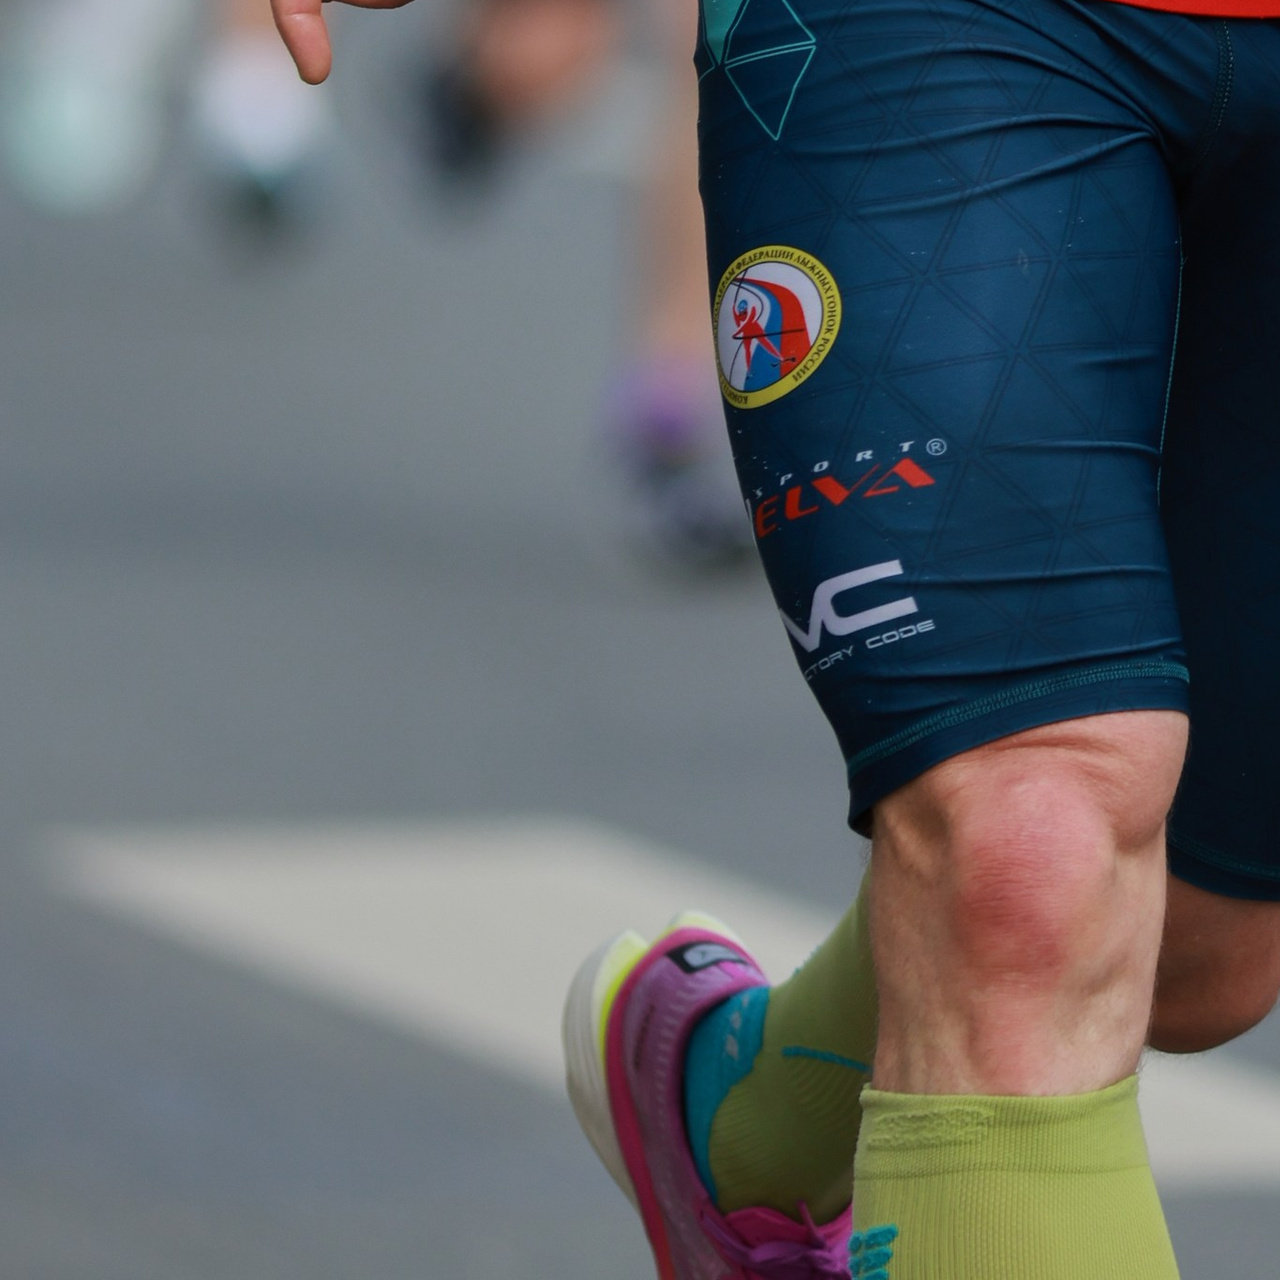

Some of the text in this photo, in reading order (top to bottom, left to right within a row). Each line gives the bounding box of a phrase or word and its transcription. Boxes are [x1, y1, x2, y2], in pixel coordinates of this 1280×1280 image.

[735, 249, 795, 271] ФЕДЕРАЦИИ
[794, 253, 833, 295] ЛЫЖНЫХ
[823, 292, 837, 335] ГОНОК
[792, 338, 830, 382] РОССИИ
[803, 619, 936, 681] CTORY CODE
